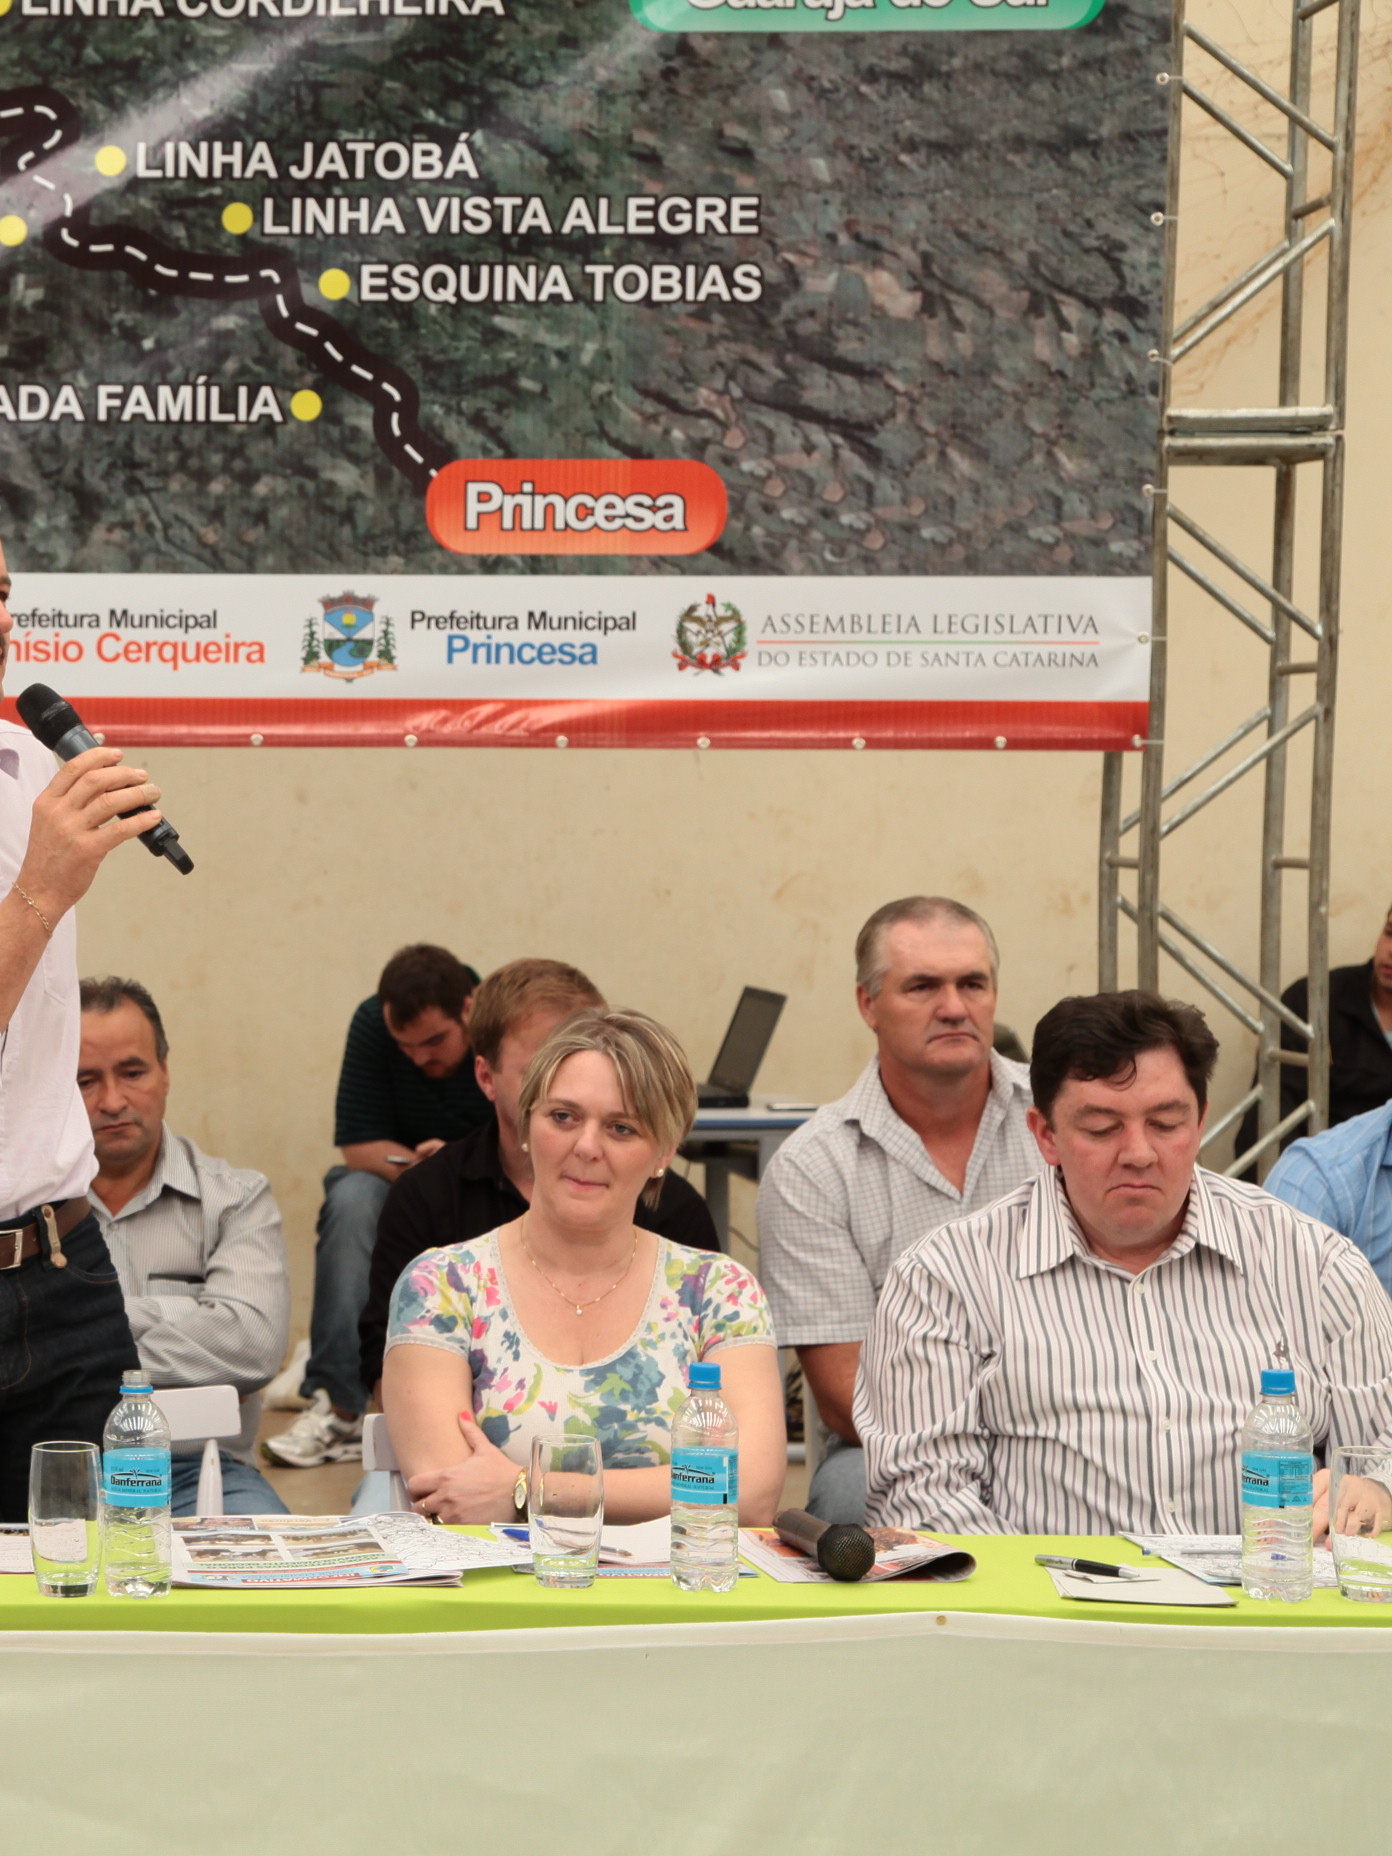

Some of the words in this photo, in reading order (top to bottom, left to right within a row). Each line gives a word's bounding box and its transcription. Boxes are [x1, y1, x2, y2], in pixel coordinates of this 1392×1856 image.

[136, 142, 278, 178] LINHA
[290, 132, 479, 179] JATOBÁ
[263, 197, 406, 234] LINHA
[417, 196, 551, 234] VISTA
[562, 196, 759, 234] ALEGRE
[360, 264, 573, 304] ESQUINA
[585, 264, 762, 301] TOBIAS
[97, 375, 283, 422] FAMÍLIA
[465, 481, 686, 531] Princesa
[12, 608, 101, 629] efeitura
[109, 609, 218, 630] Municipal
[410, 610, 519, 630] Prefeitura
[528, 611, 637, 633] Municipal
[761, 613, 921, 635] ASSEMBLEIA
[932, 613, 1100, 636] LEGISLATIVA
[9, 631, 85, 664] nísio
[95, 631, 267, 673] Cerqueira
[446, 633, 598, 665] Princesa
[757, 651, 791, 667] DO
[798, 651, 879, 667] ESTADO
[887, 651, 912, 668] DE
[920, 651, 987, 668] SANTA
[993, 651, 1100, 669] CATARINA
[110, 1475, 162, 1487] Danferrana
